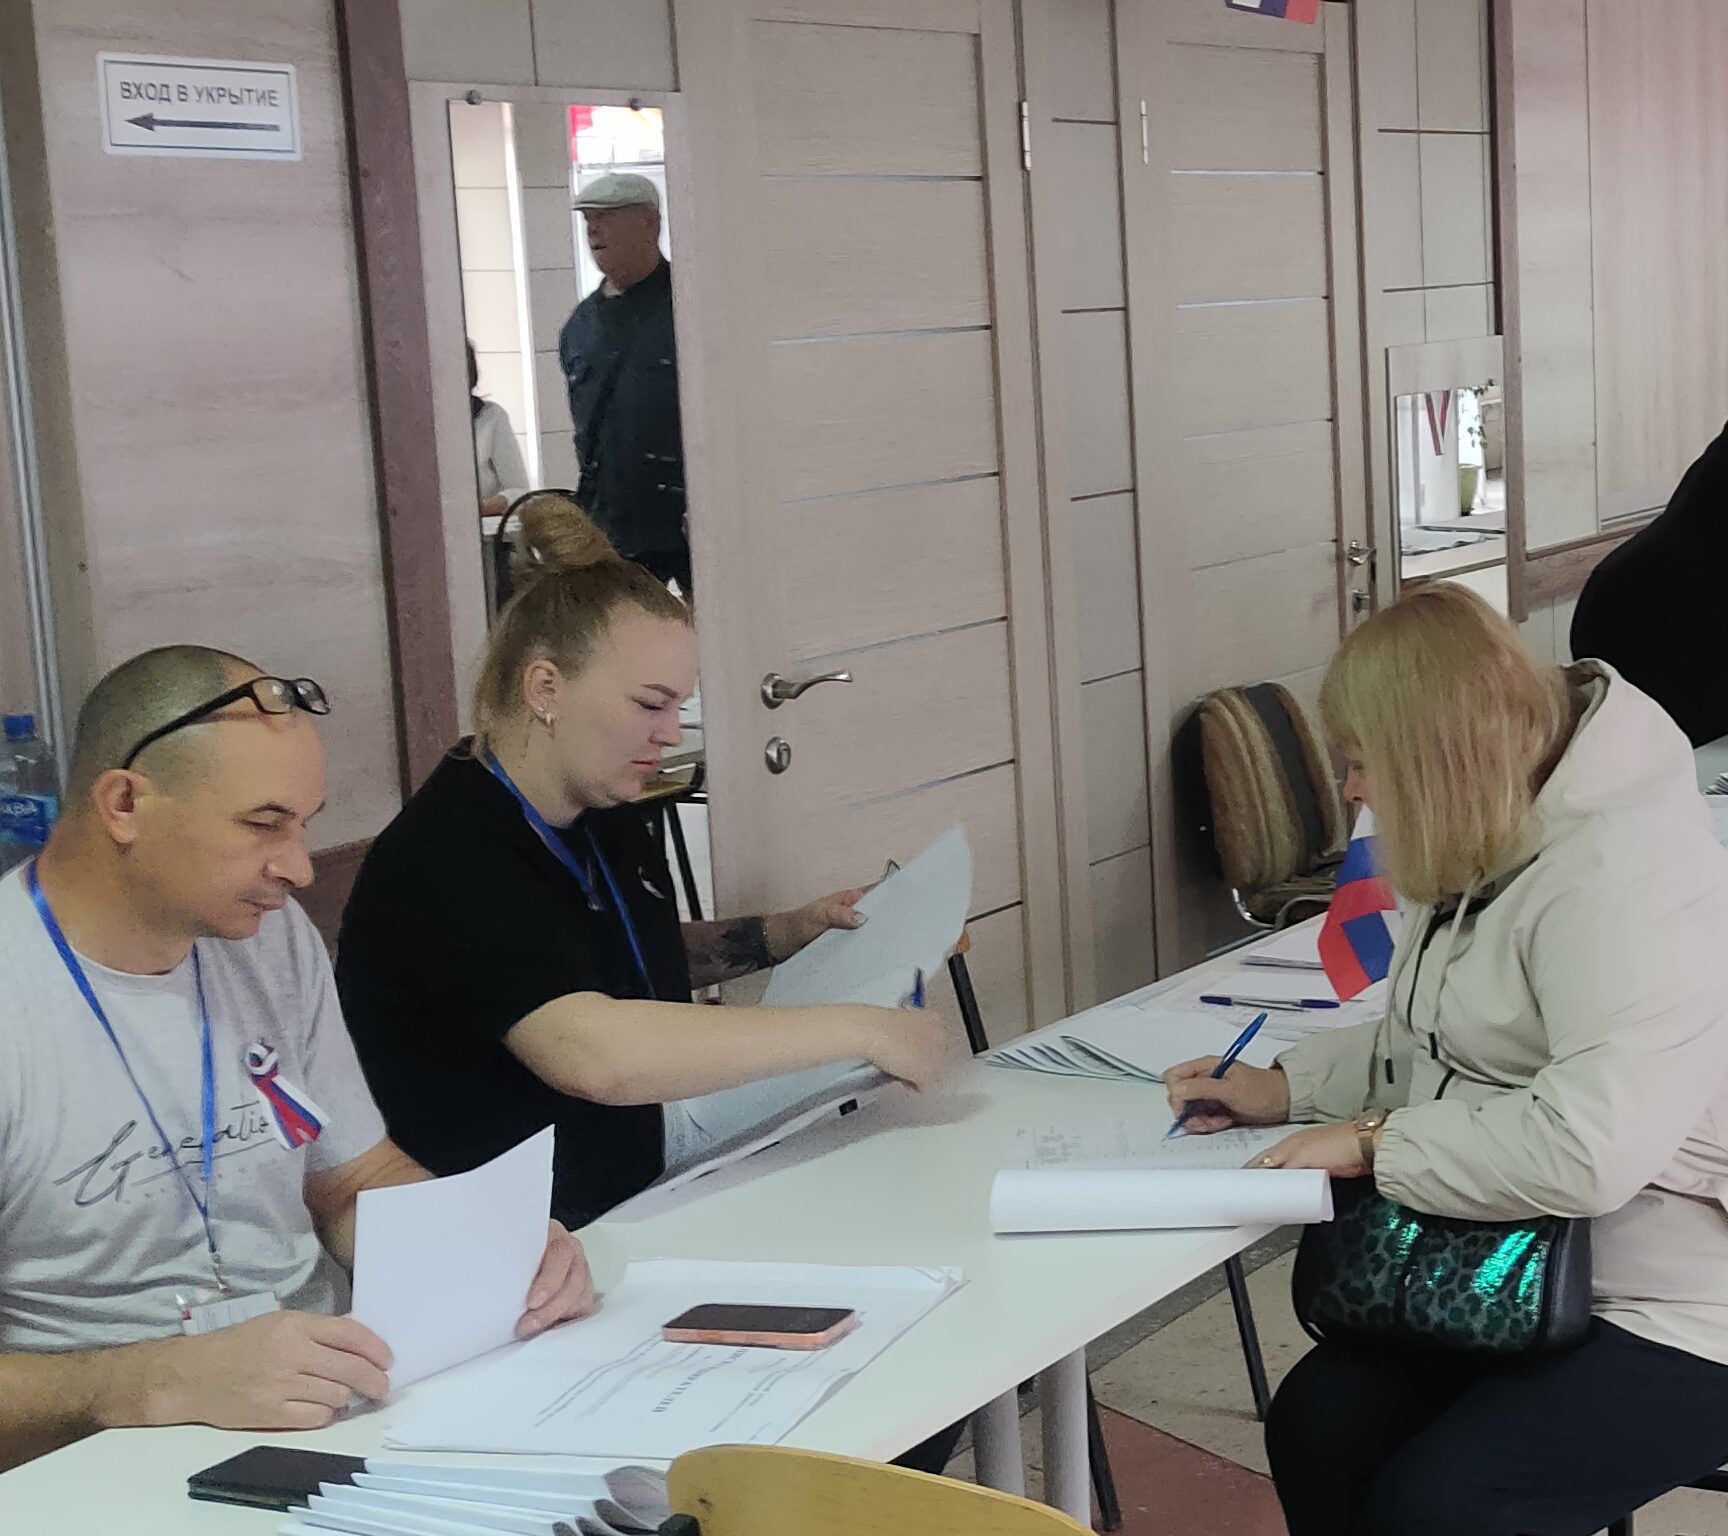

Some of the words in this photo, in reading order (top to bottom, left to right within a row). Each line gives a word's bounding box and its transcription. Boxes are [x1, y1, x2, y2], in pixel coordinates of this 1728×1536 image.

[120, 81, 172, 104] ВХОД
[177, 84, 189, 103] В
[193, 85, 280, 108] УКРЫТИЕ
